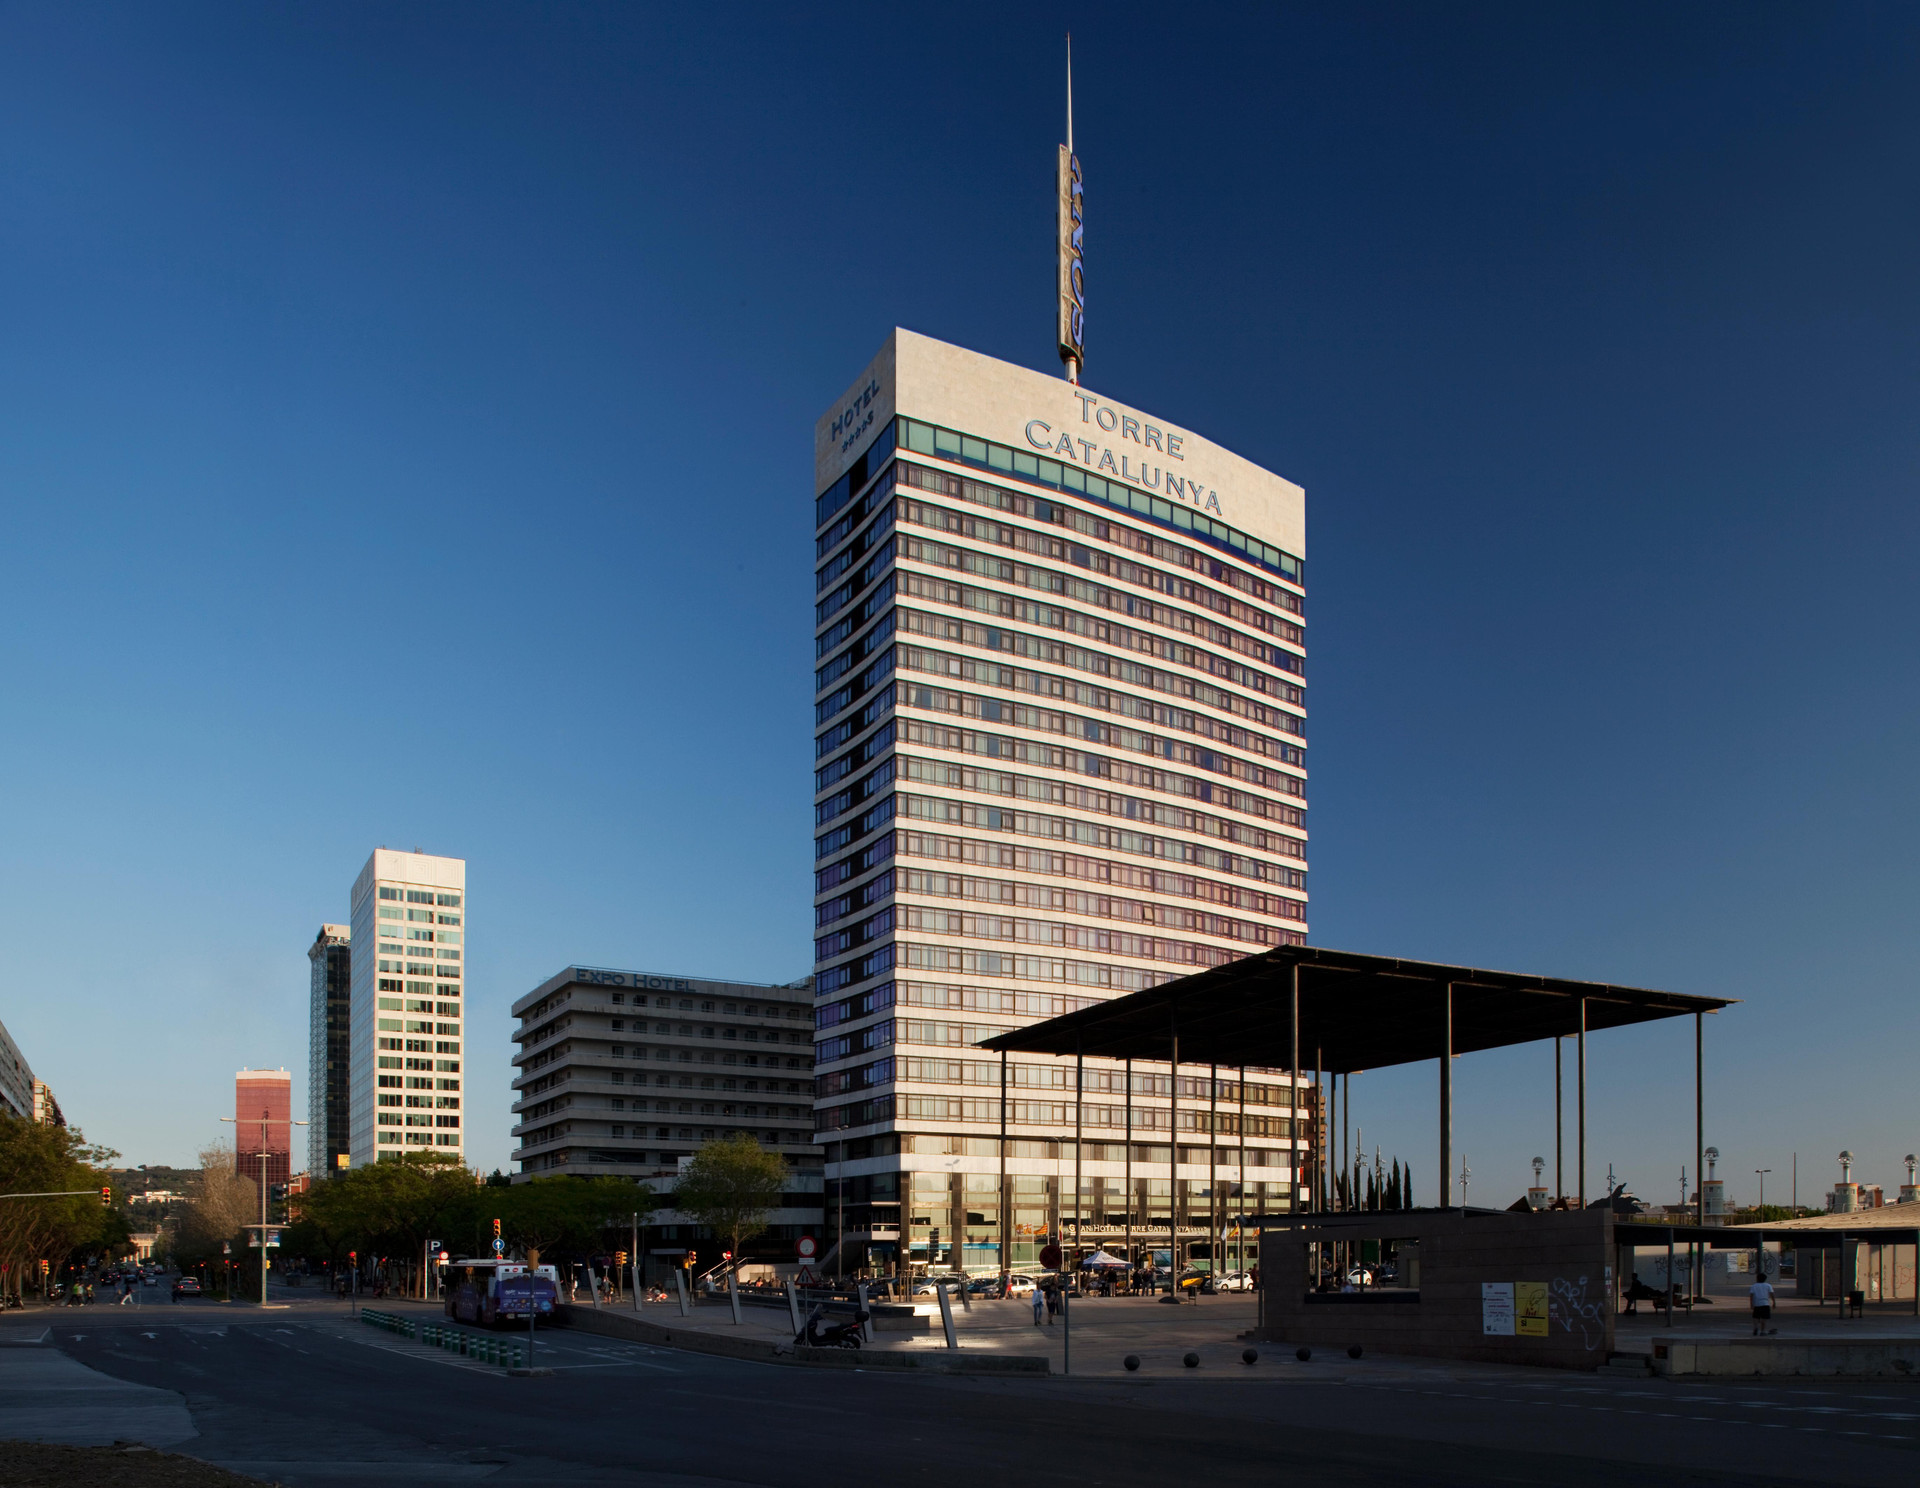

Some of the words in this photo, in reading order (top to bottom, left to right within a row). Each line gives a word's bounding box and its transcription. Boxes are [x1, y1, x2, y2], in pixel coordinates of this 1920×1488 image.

[831, 379, 880, 442] HOTEL
[1074, 390, 1185, 461] TORRE
[1025, 419, 1222, 516] CATALUNYA
[576, 967, 626, 985] EXPO
[633, 973, 697, 993] HOTEL
[430, 1240, 441, 1251] P
[1068, 1223, 1092, 1232] GAN
[1093, 1223, 1119, 1232] HOTEL
[1120, 1223, 1146, 1232] TRRE
[1147, 1224, 1189, 1233] CATALNYA
